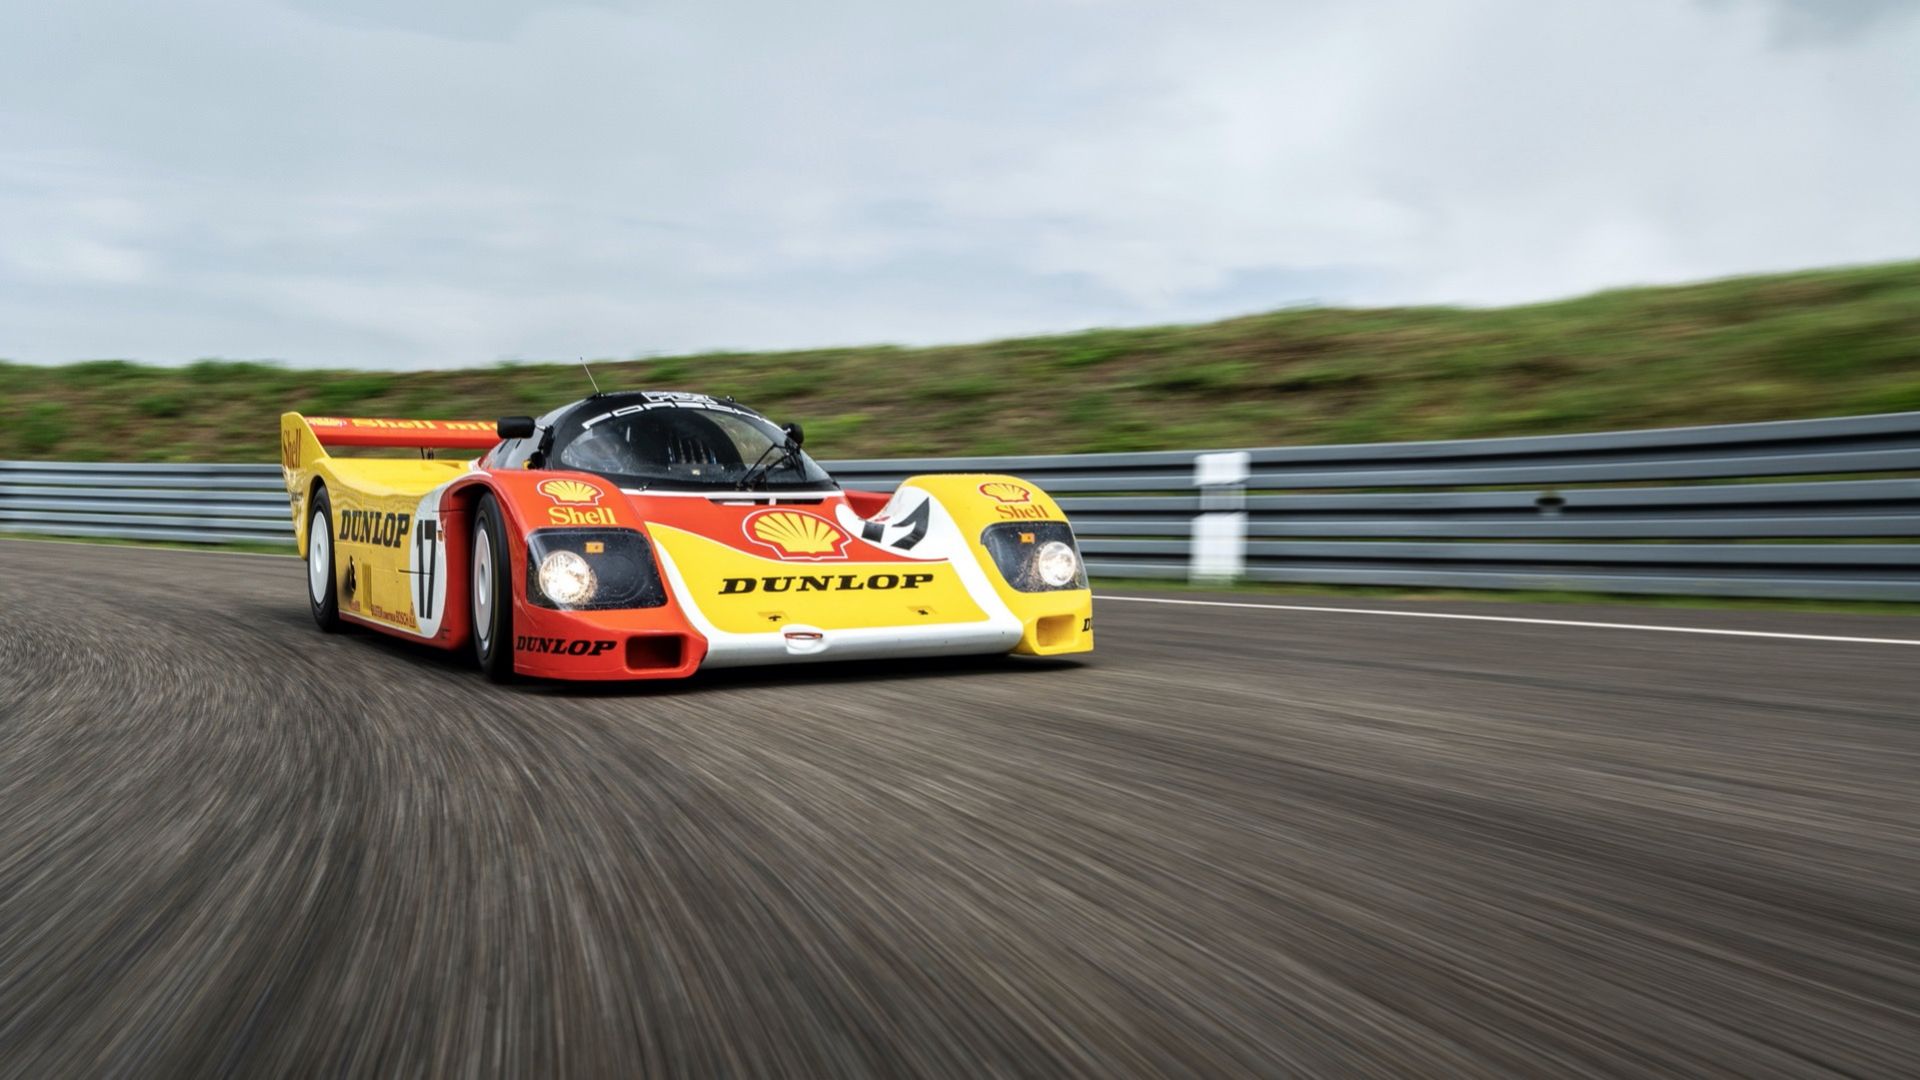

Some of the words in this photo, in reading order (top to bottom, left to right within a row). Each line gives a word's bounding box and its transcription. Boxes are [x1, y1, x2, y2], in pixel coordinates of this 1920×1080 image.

[352, 418, 436, 429] Shell
[283, 428, 301, 469] Shell
[548, 506, 618, 525] Shell
[995, 504, 1050, 519] Shell
[339, 510, 410, 548] DUNLOP
[416, 519, 437, 619] 17
[718, 573, 934, 595] DUNLOP
[516, 636, 617, 656] DUNLOP
